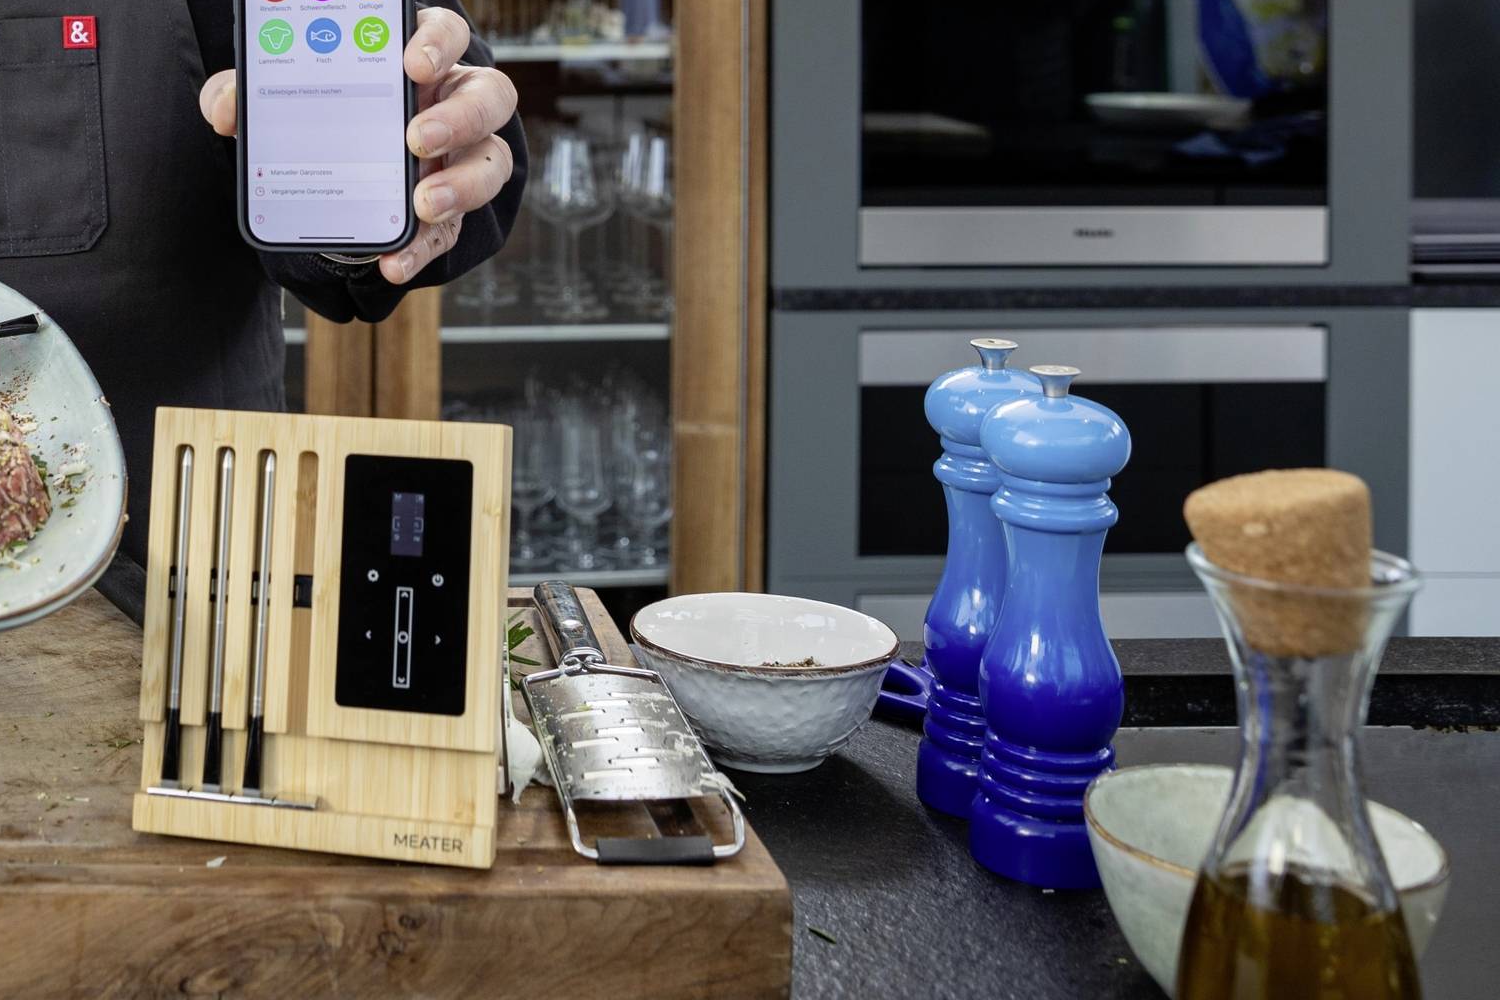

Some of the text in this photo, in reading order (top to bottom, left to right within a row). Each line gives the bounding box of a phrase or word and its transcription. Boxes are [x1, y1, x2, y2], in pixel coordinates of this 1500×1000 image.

[70, 21, 90, 44] &
[357, 56, 387, 64] Sonstiges
[393, 832, 463, 854] MEATER
